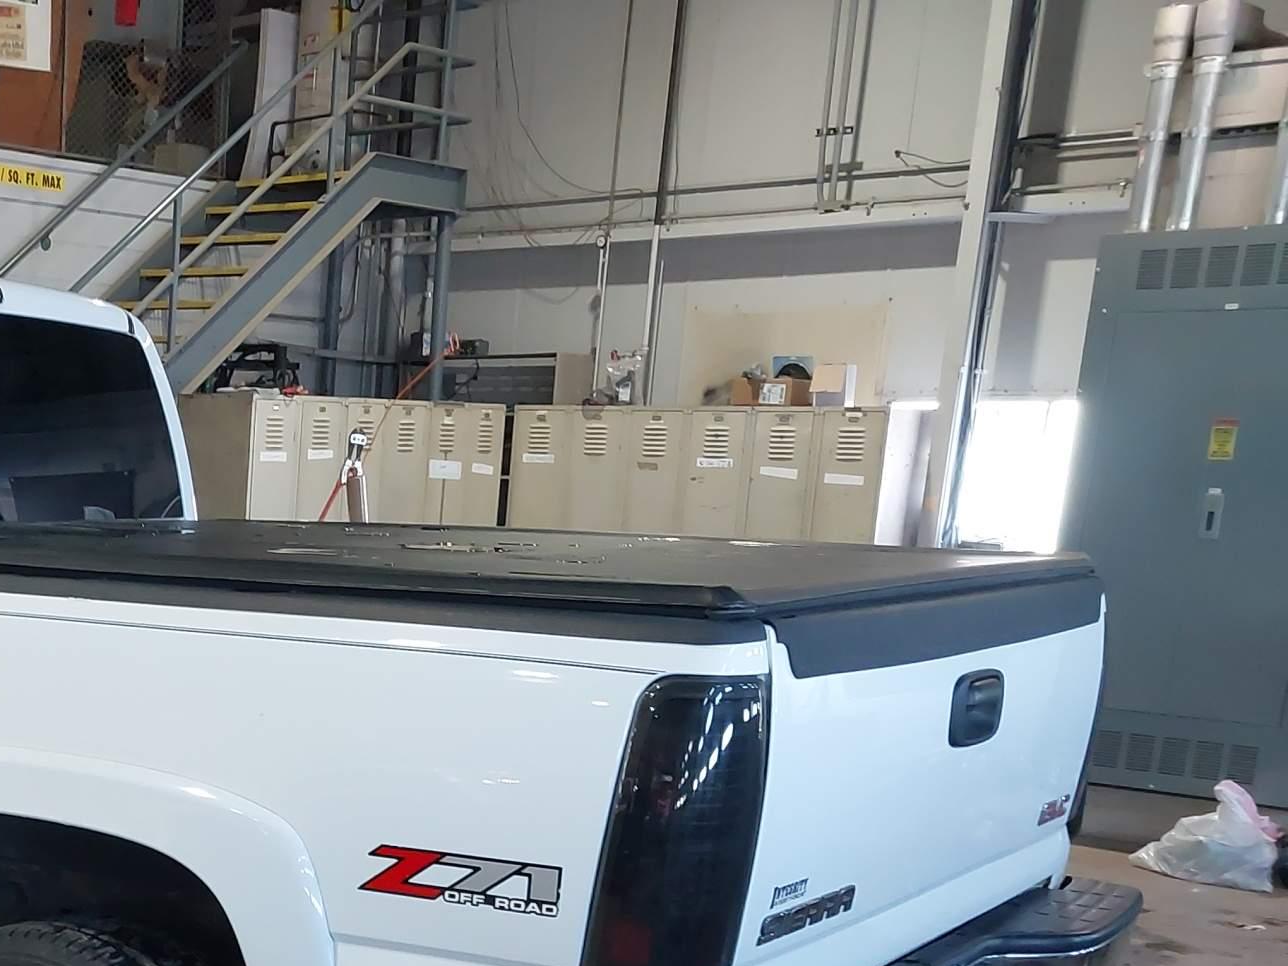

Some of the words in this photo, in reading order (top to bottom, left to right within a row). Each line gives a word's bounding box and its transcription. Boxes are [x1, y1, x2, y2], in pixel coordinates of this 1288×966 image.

[7, 169, 22, 185] SQ.
[26, 172, 38, 187] FT.
[42, 174, 62, 190] MAX
[358, 844, 563, 903] Z71
[443, 889, 486, 907] OFF
[494, 897, 559, 917] ROAD
